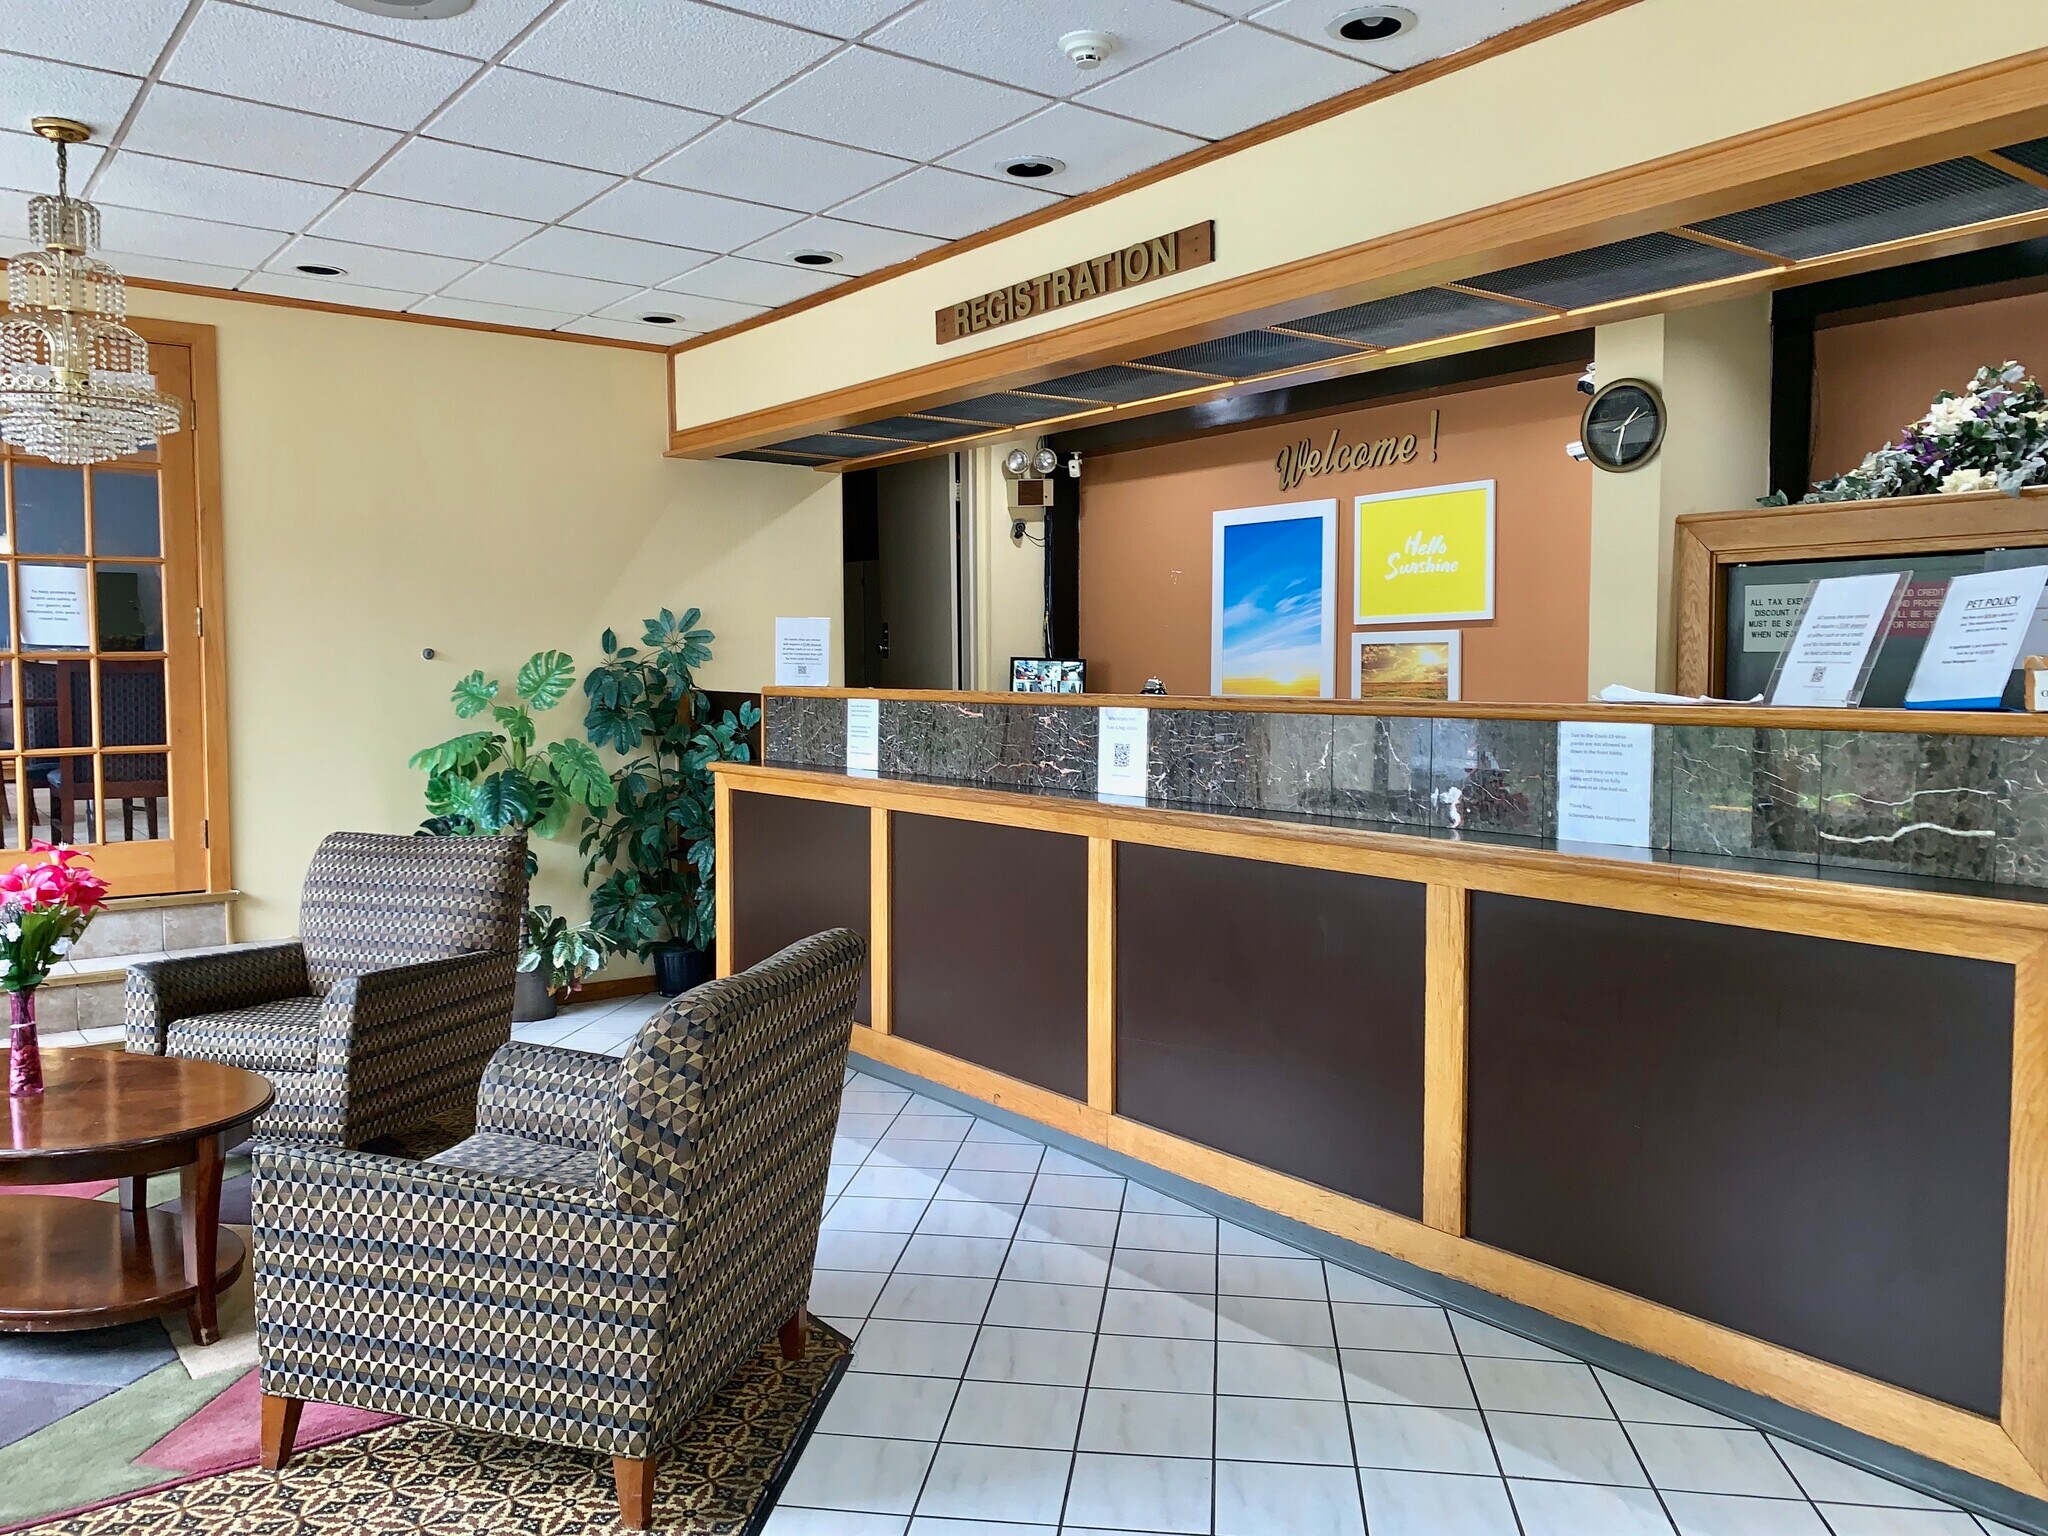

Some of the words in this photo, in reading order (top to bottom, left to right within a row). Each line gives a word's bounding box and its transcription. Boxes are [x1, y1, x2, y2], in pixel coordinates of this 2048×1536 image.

[953, 232, 1177, 337] REGISTRATION
[1275, 429, 1418, 492] Welcome
[1405, 530, 1447, 557] Hello
[1384, 552, 1459, 580] Sunshine
[1917, 588, 1945, 597] CREDIT
[1767, 598, 1782, 606] TAX
[1966, 599, 1985, 609] PET
[1985, 596, 2021, 607] POLICY
[1754, 608, 1790, 617] DISCOUNT
[1910, 610, 1921, 618] BE
[1748, 620, 1768, 628] MUST
[1771, 619, 1781, 628] BE
[1751, 630, 1772, 638] WHEN
